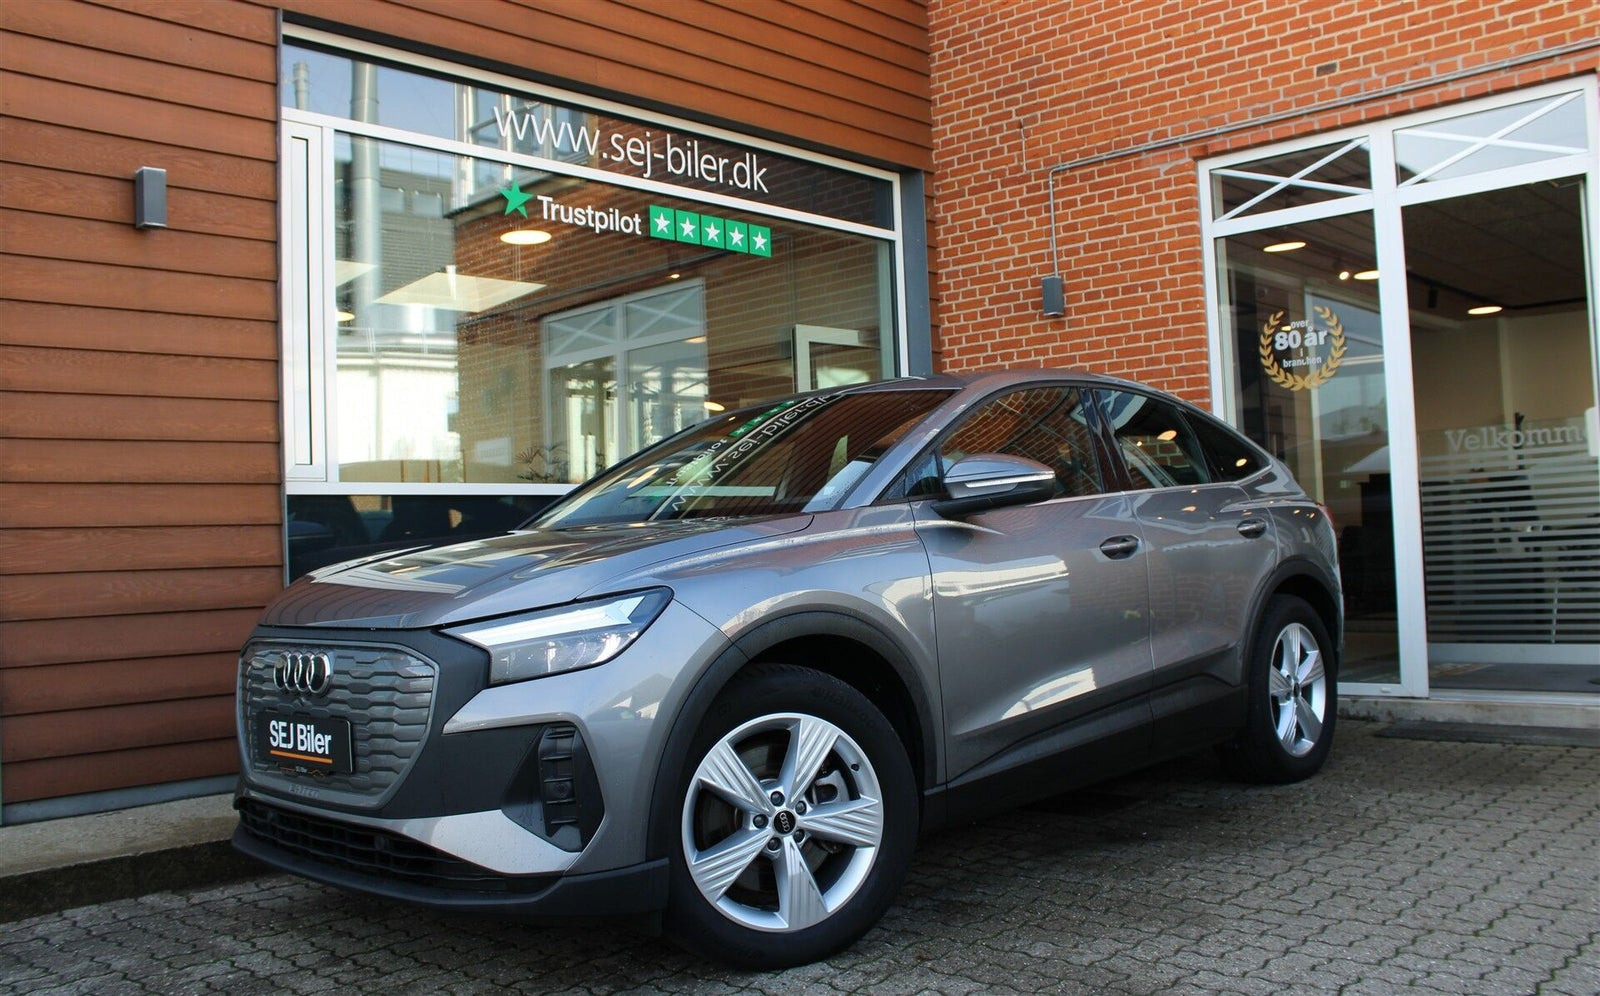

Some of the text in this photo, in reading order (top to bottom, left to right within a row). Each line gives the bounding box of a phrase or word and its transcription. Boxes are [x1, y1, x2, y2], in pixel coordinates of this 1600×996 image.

[493, 106, 769, 193] www.sej-biler.dk
[537, 195, 642, 234] Trustpilot
[1274, 325, 1328, 350] 80 år
[1291, 320, 1309, 329] over
[1445, 425, 1588, 450] Velkomm
[269, 720, 332, 754] SEJ Biler
